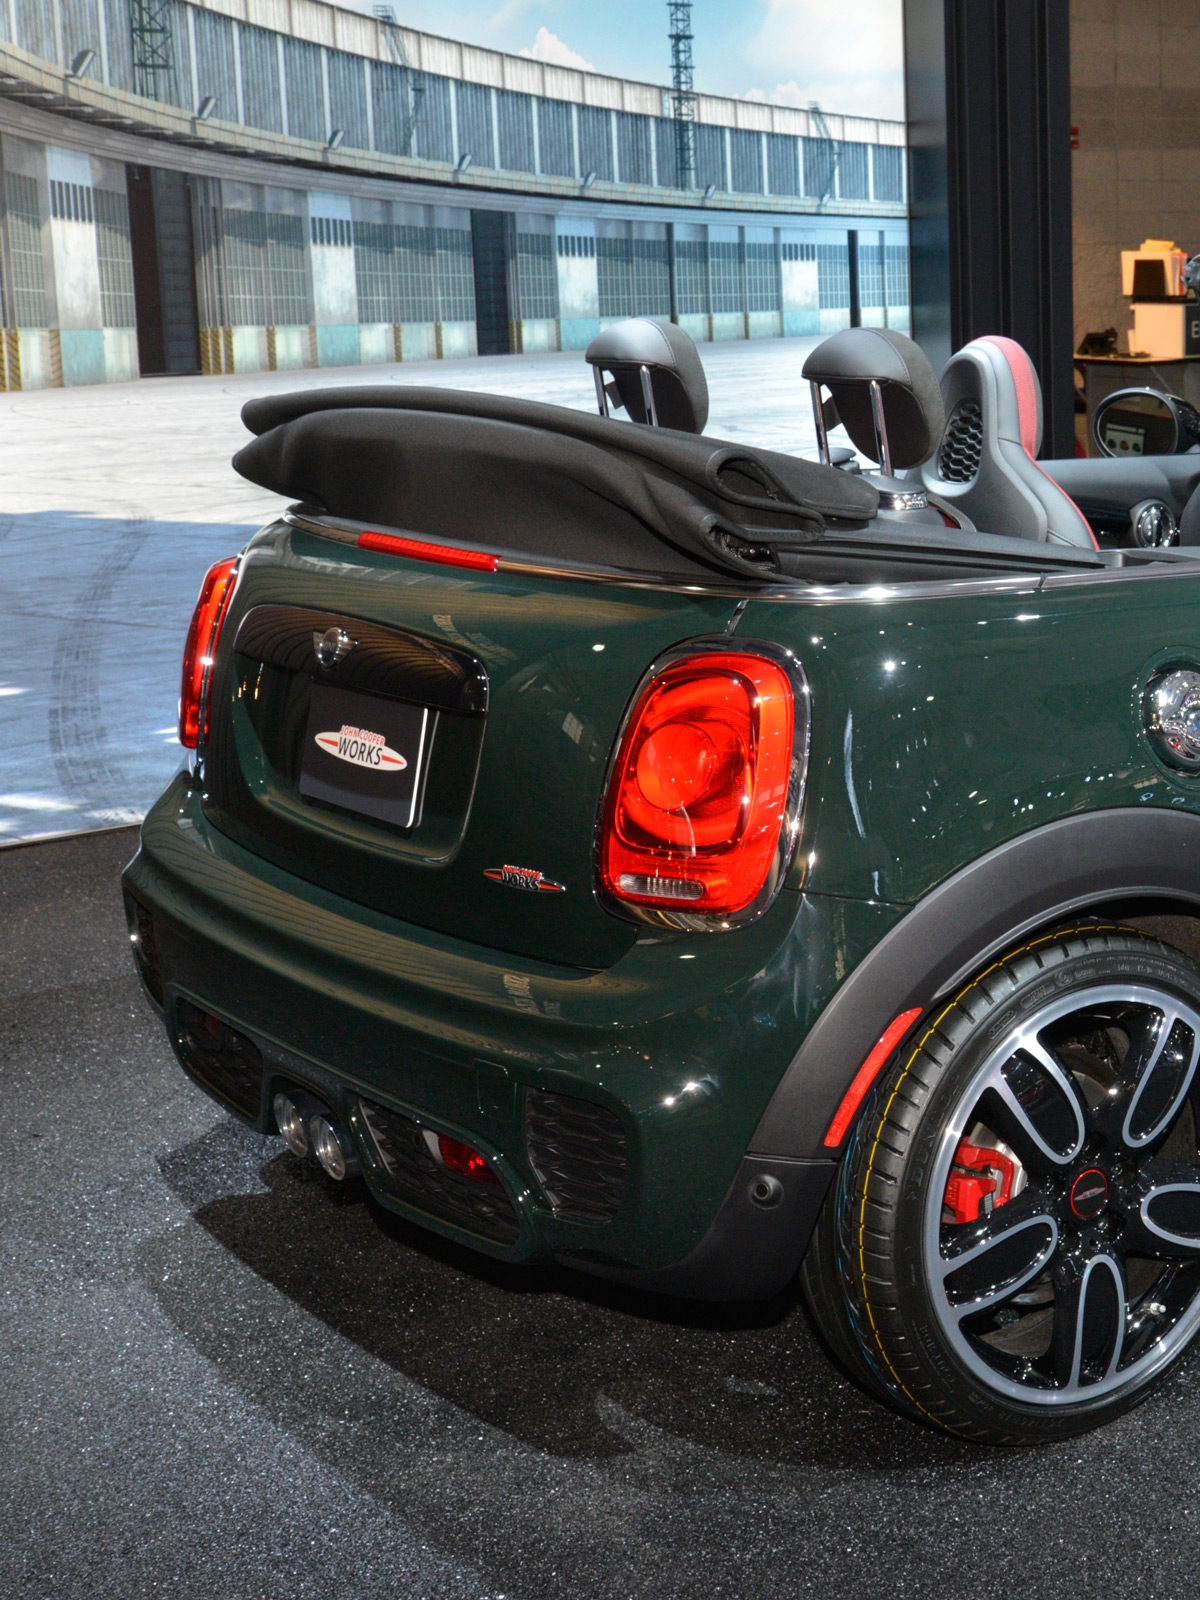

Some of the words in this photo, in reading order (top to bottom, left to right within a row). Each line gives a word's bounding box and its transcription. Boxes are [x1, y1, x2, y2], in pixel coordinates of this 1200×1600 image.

[339, 725, 359, 738] JOHN
[359, 729, 386, 745] COOPER
[338, 736, 383, 766] WORKS
[502, 871, 540, 890] WORKS
